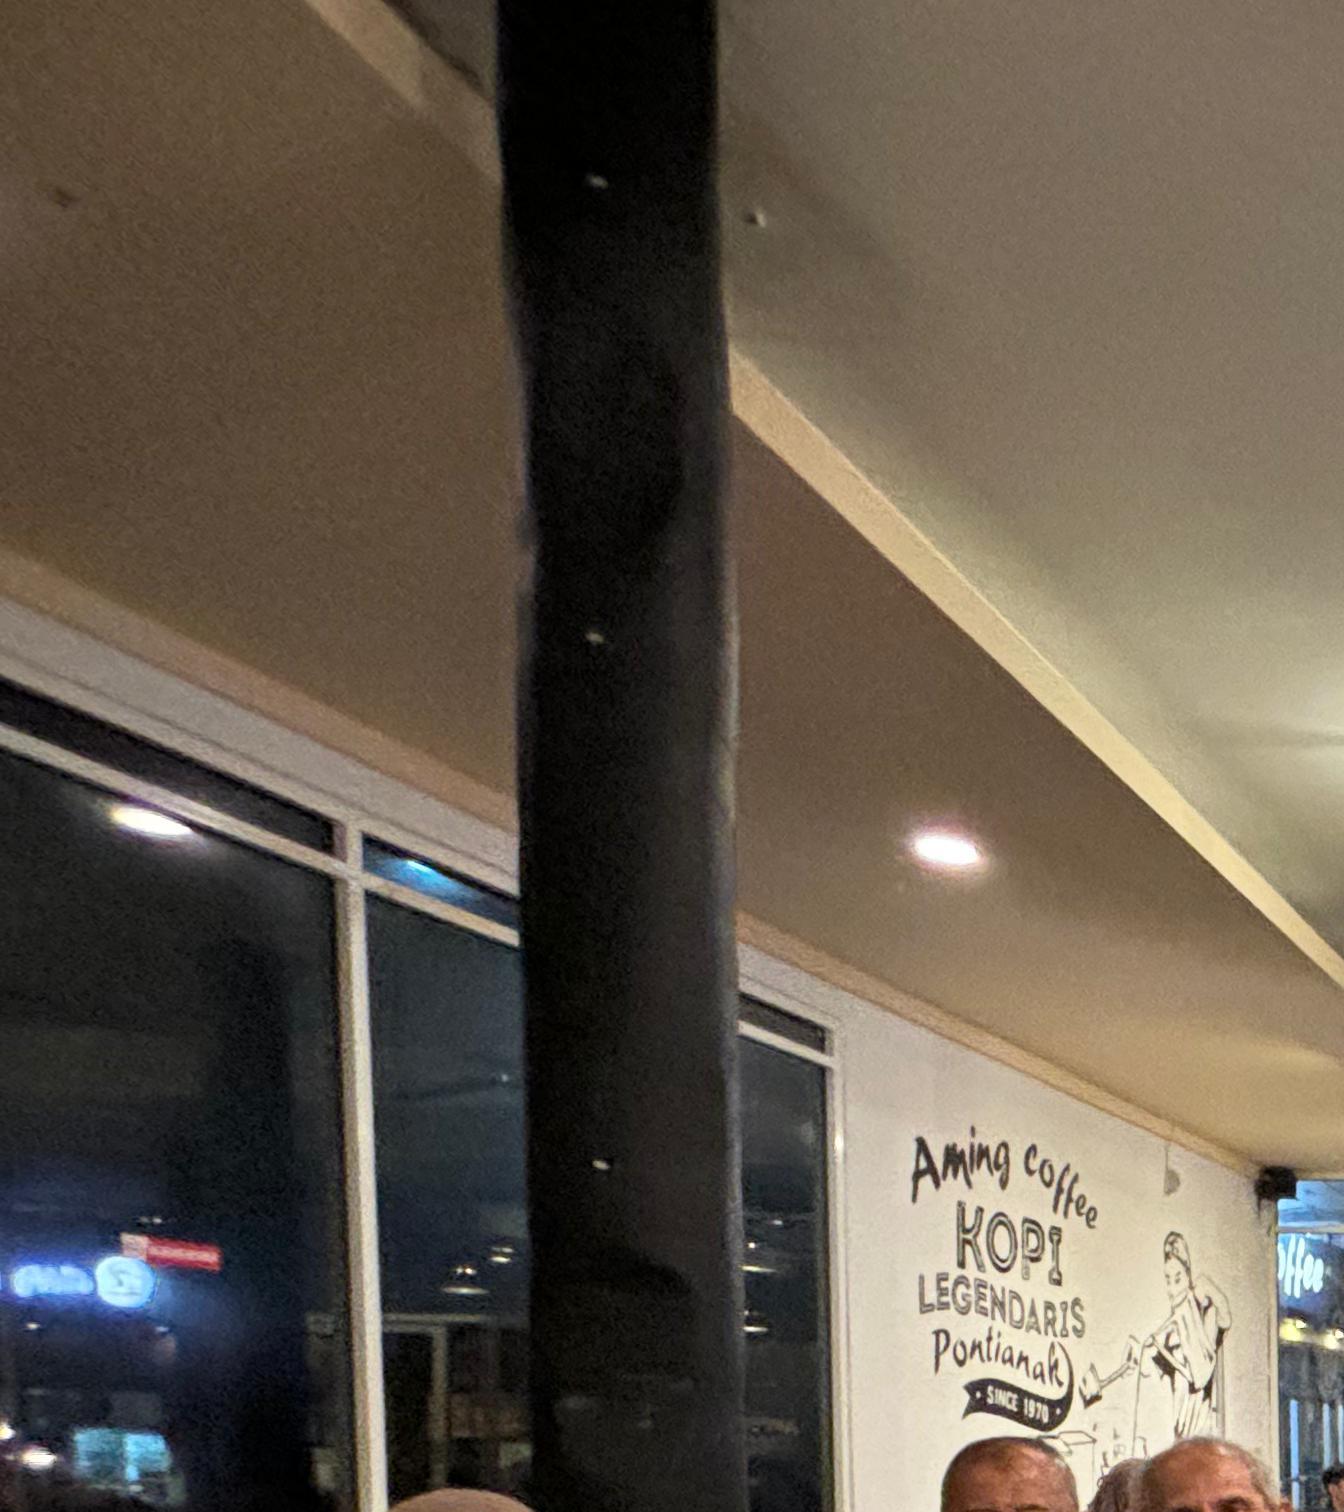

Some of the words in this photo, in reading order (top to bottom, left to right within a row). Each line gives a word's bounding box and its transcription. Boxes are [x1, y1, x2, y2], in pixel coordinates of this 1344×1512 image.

[911, 1125, 1010, 1203] Aming
[956, 1200, 1063, 1286] KOPI
[918, 1272, 1087, 1338] LEGENDARIS
[932, 1326, 1064, 1387] Pontianak
[987, 1385, 1018, 1412] SINCE
